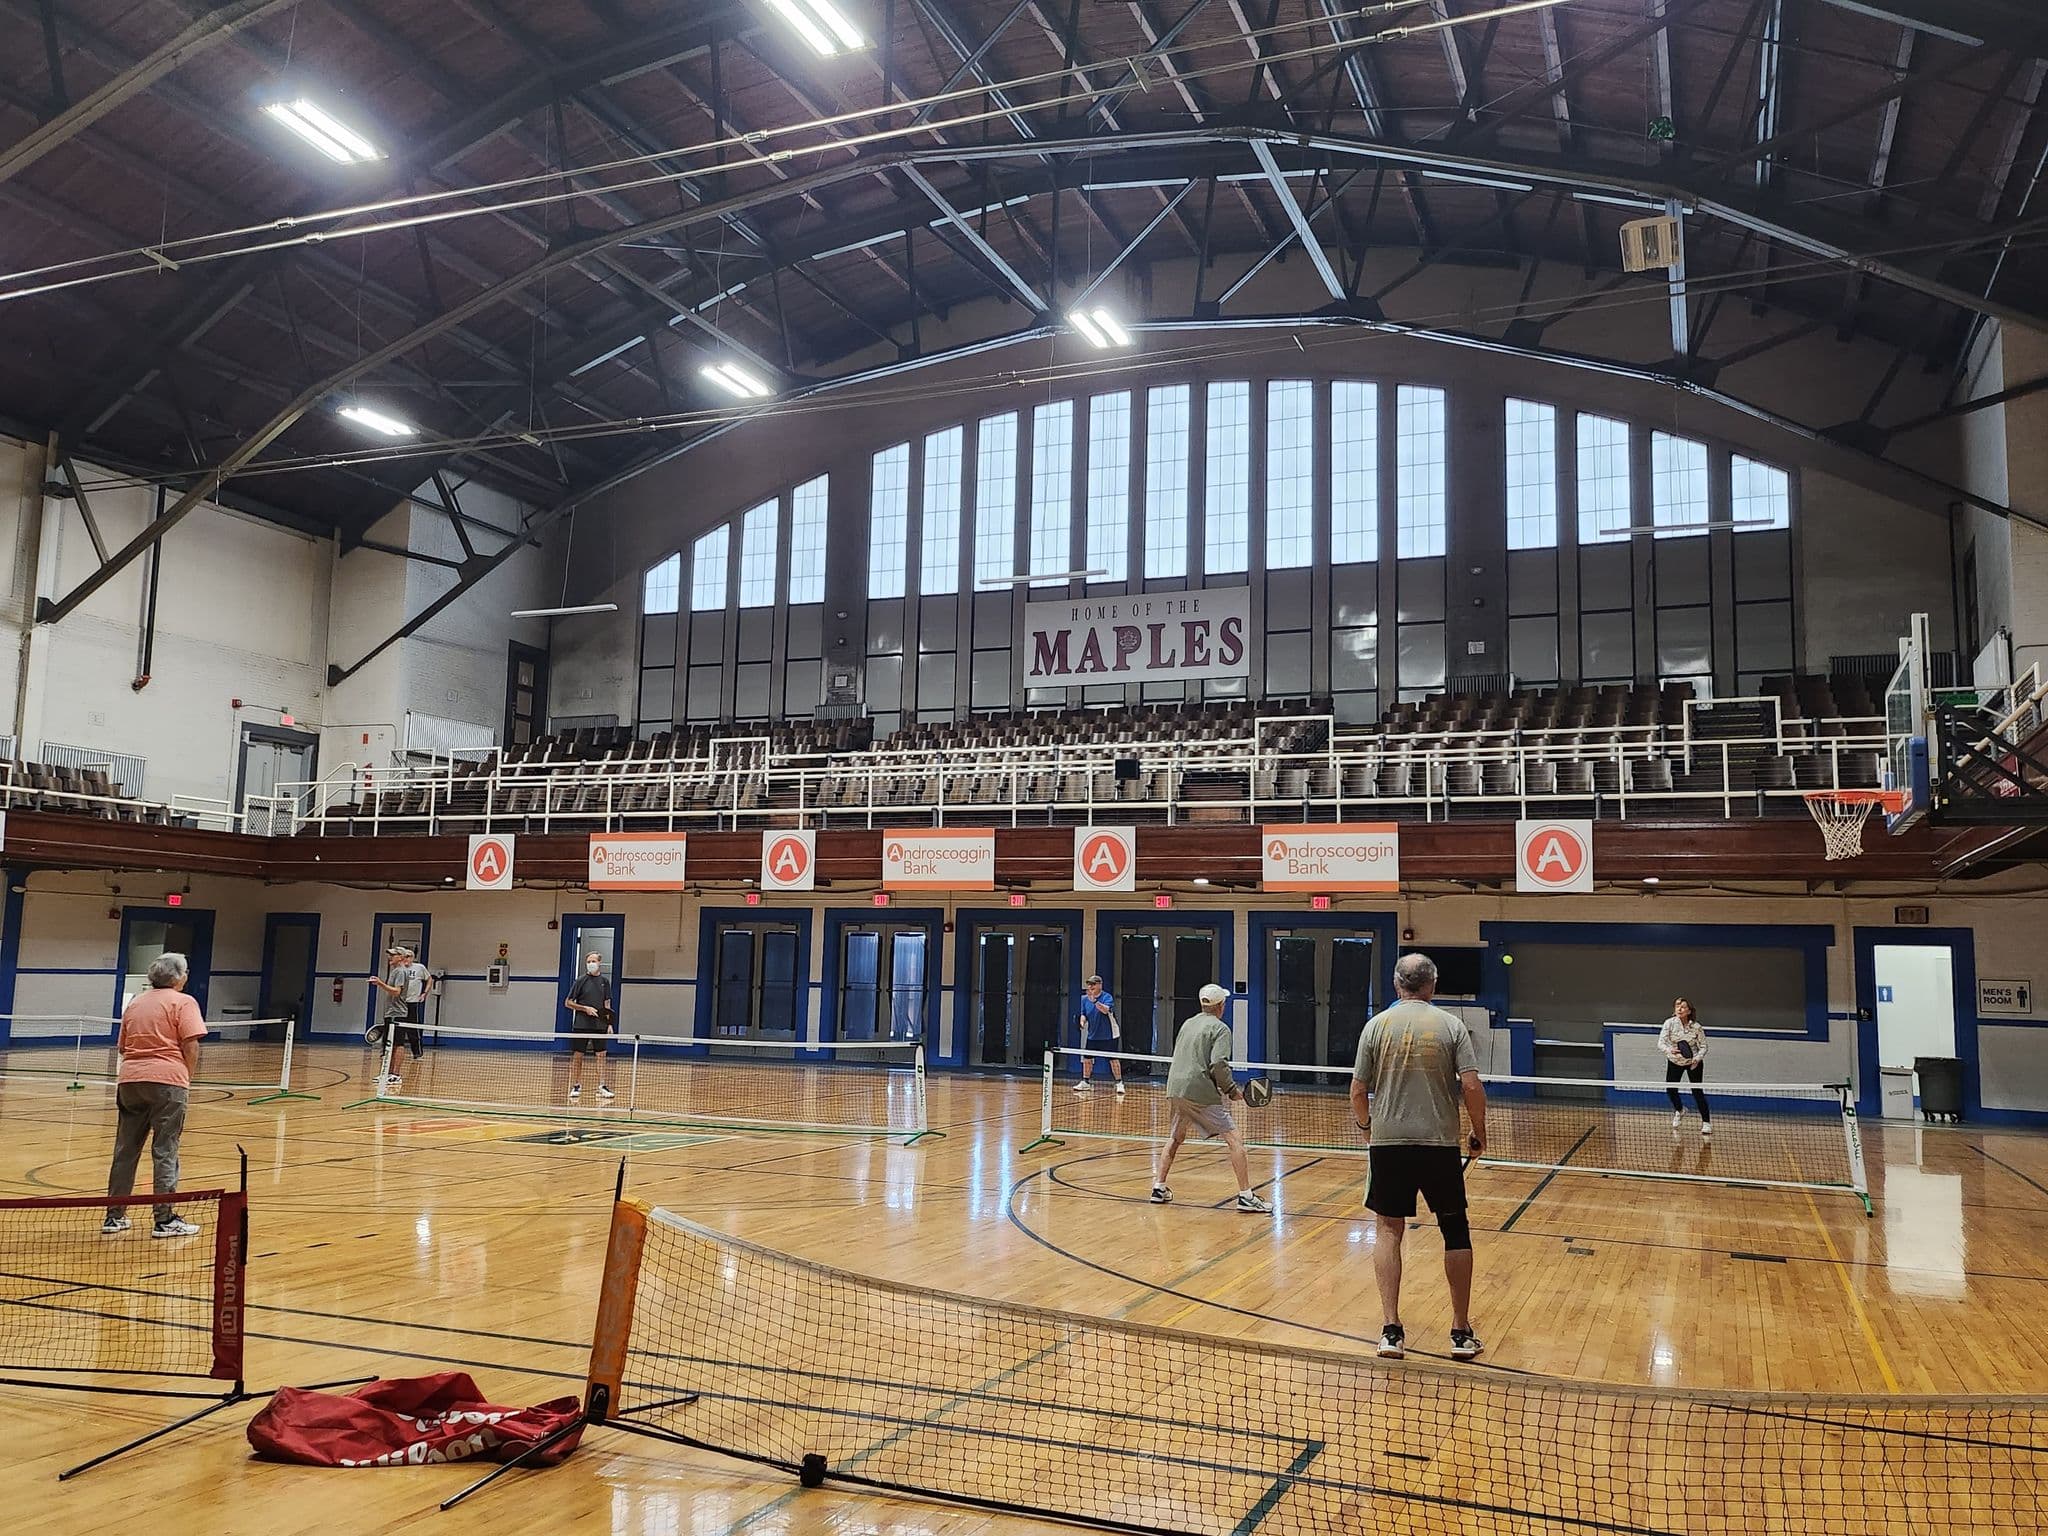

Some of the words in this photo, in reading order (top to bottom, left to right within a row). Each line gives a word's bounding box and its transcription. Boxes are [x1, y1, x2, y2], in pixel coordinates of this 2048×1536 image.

[1071, 605, 1119, 622] HOME
[1132, 602, 1152, 617] OF
[1166, 599, 1200, 614] THE
[1030, 617, 1243, 675] MAPLES
[477, 847, 500, 875] A
[592, 845, 682, 865] Androscoggin
[773, 844, 800, 874] A
[887, 842, 991, 863] Androscoggin
[1088, 842, 1119, 874] A
[1267, 839, 1394, 862] Androscoggin
[1535, 837, 1573, 873] A
[607, 862, 636, 876] Bank
[903, 860, 937, 875] Bank
[1288, 858, 1329, 875] Bank
[1982, 988, 2012, 996] MEN'S
[1983, 996, 2012, 1004] ROOM
[222, 1234, 239, 1304] Wilson
